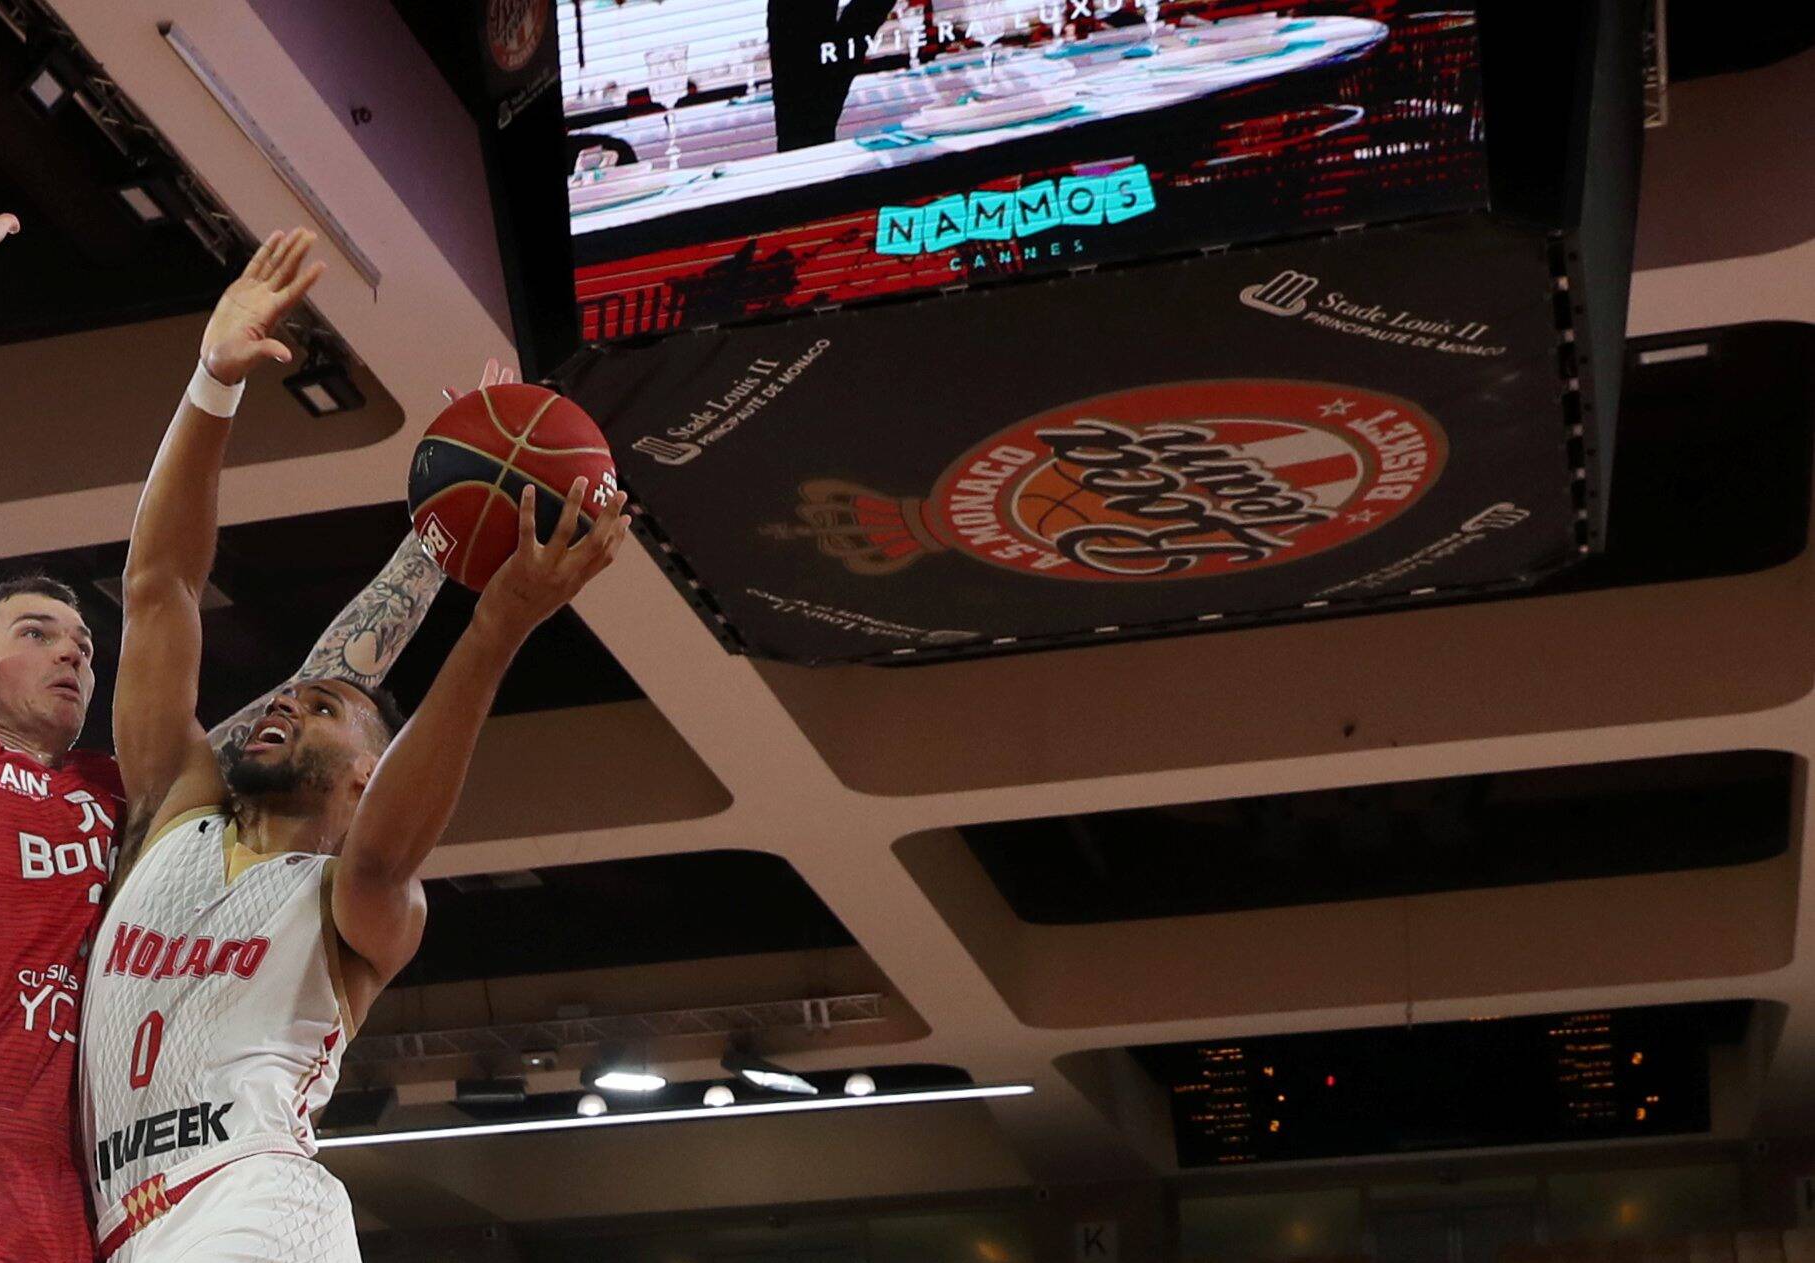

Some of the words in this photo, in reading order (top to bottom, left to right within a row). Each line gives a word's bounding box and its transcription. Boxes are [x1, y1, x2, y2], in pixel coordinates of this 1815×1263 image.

[819, 20, 986, 65] RIVIERA
[888, 182, 1138, 247] NAMMOS
[949, 240, 1085, 272] CANNES
[1318, 291, 1388, 324] Stade
[1388, 311, 1454, 336] Louis
[1454, 321, 1490, 342] II
[778, 338, 831, 385] MONACO
[667, 409, 719, 440] Stade
[706, 376, 761, 412] Louis
[747, 357, 780, 375] II
[1348, 408, 1430, 502] BASKET
[1035, 418, 1272, 576] Roca
[1127, 421, 1339, 548] Team
[0, 762, 48, 797] AIN
[129, 1009, 165, 1091] 0
[1084, 1224, 1108, 1257] K
